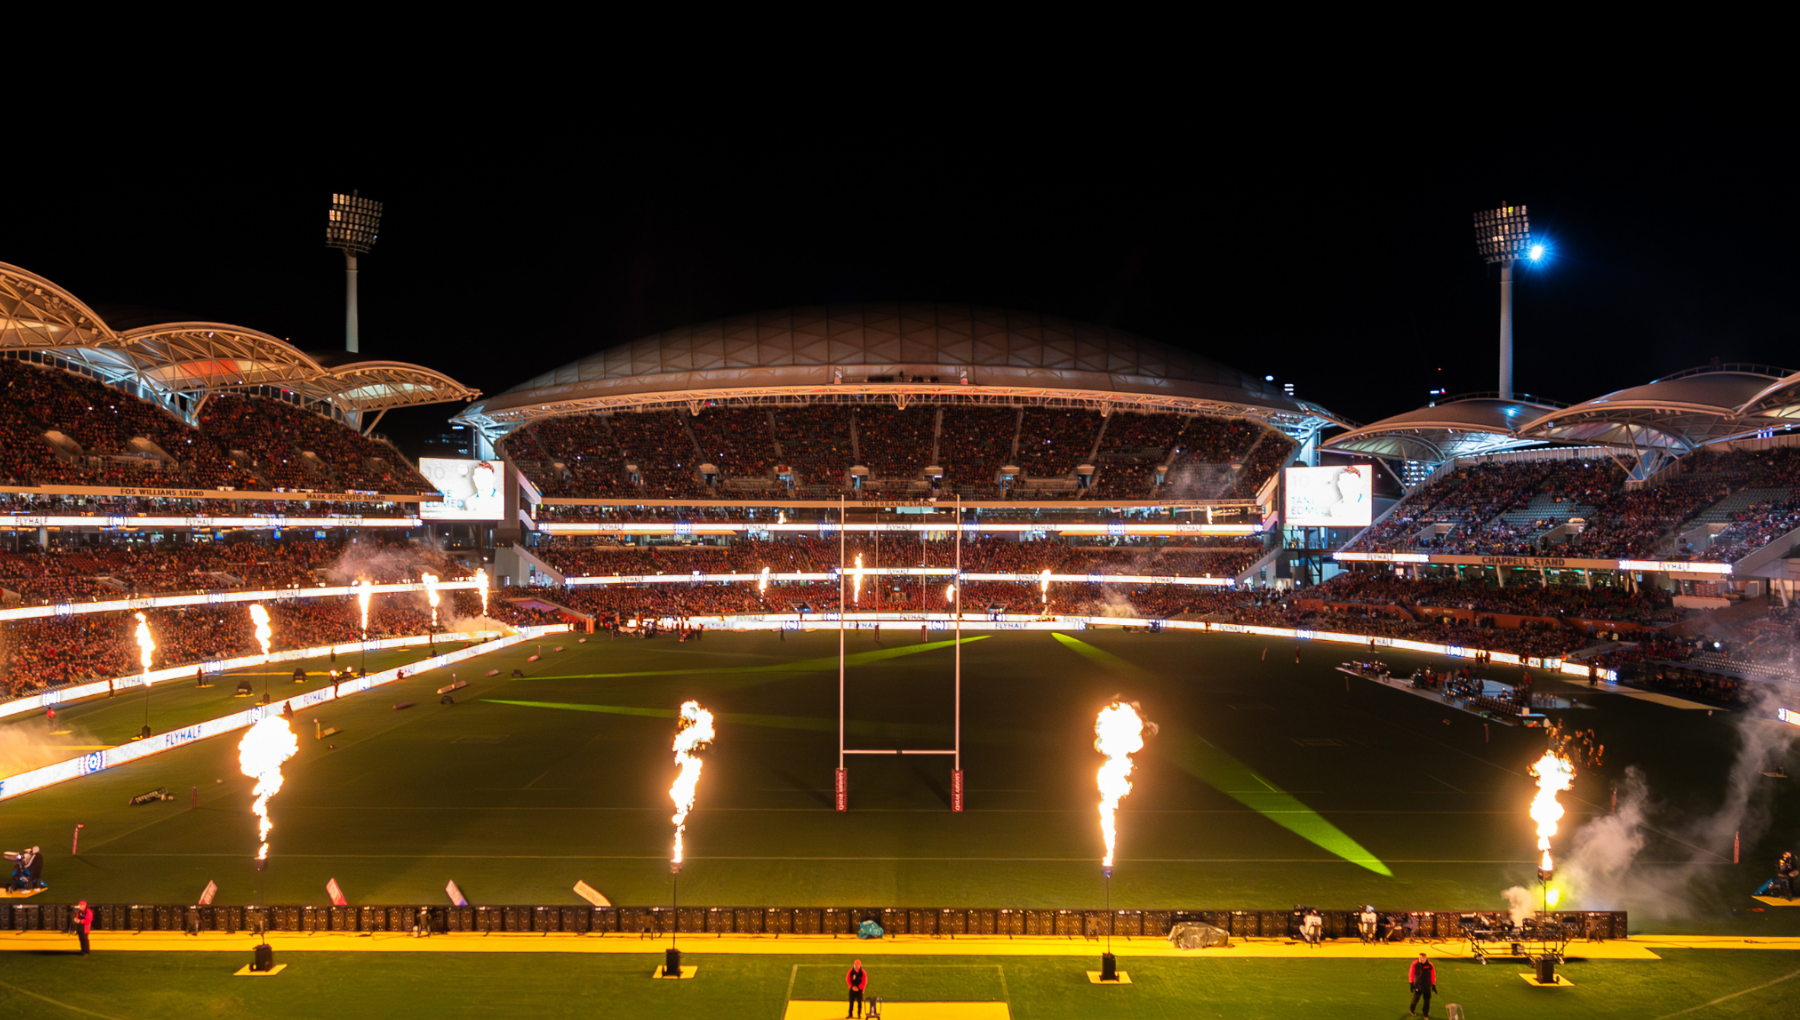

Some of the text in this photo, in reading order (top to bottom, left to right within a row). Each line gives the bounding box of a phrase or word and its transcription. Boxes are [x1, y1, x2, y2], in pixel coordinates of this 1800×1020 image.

[15, 517, 48, 525] FLYHALF
[1481, 556, 1566, 567] CHAPPELL STAND
[1659, 561, 1690, 571] FLYHALF
[166, 725, 202, 748] FLYHALF
